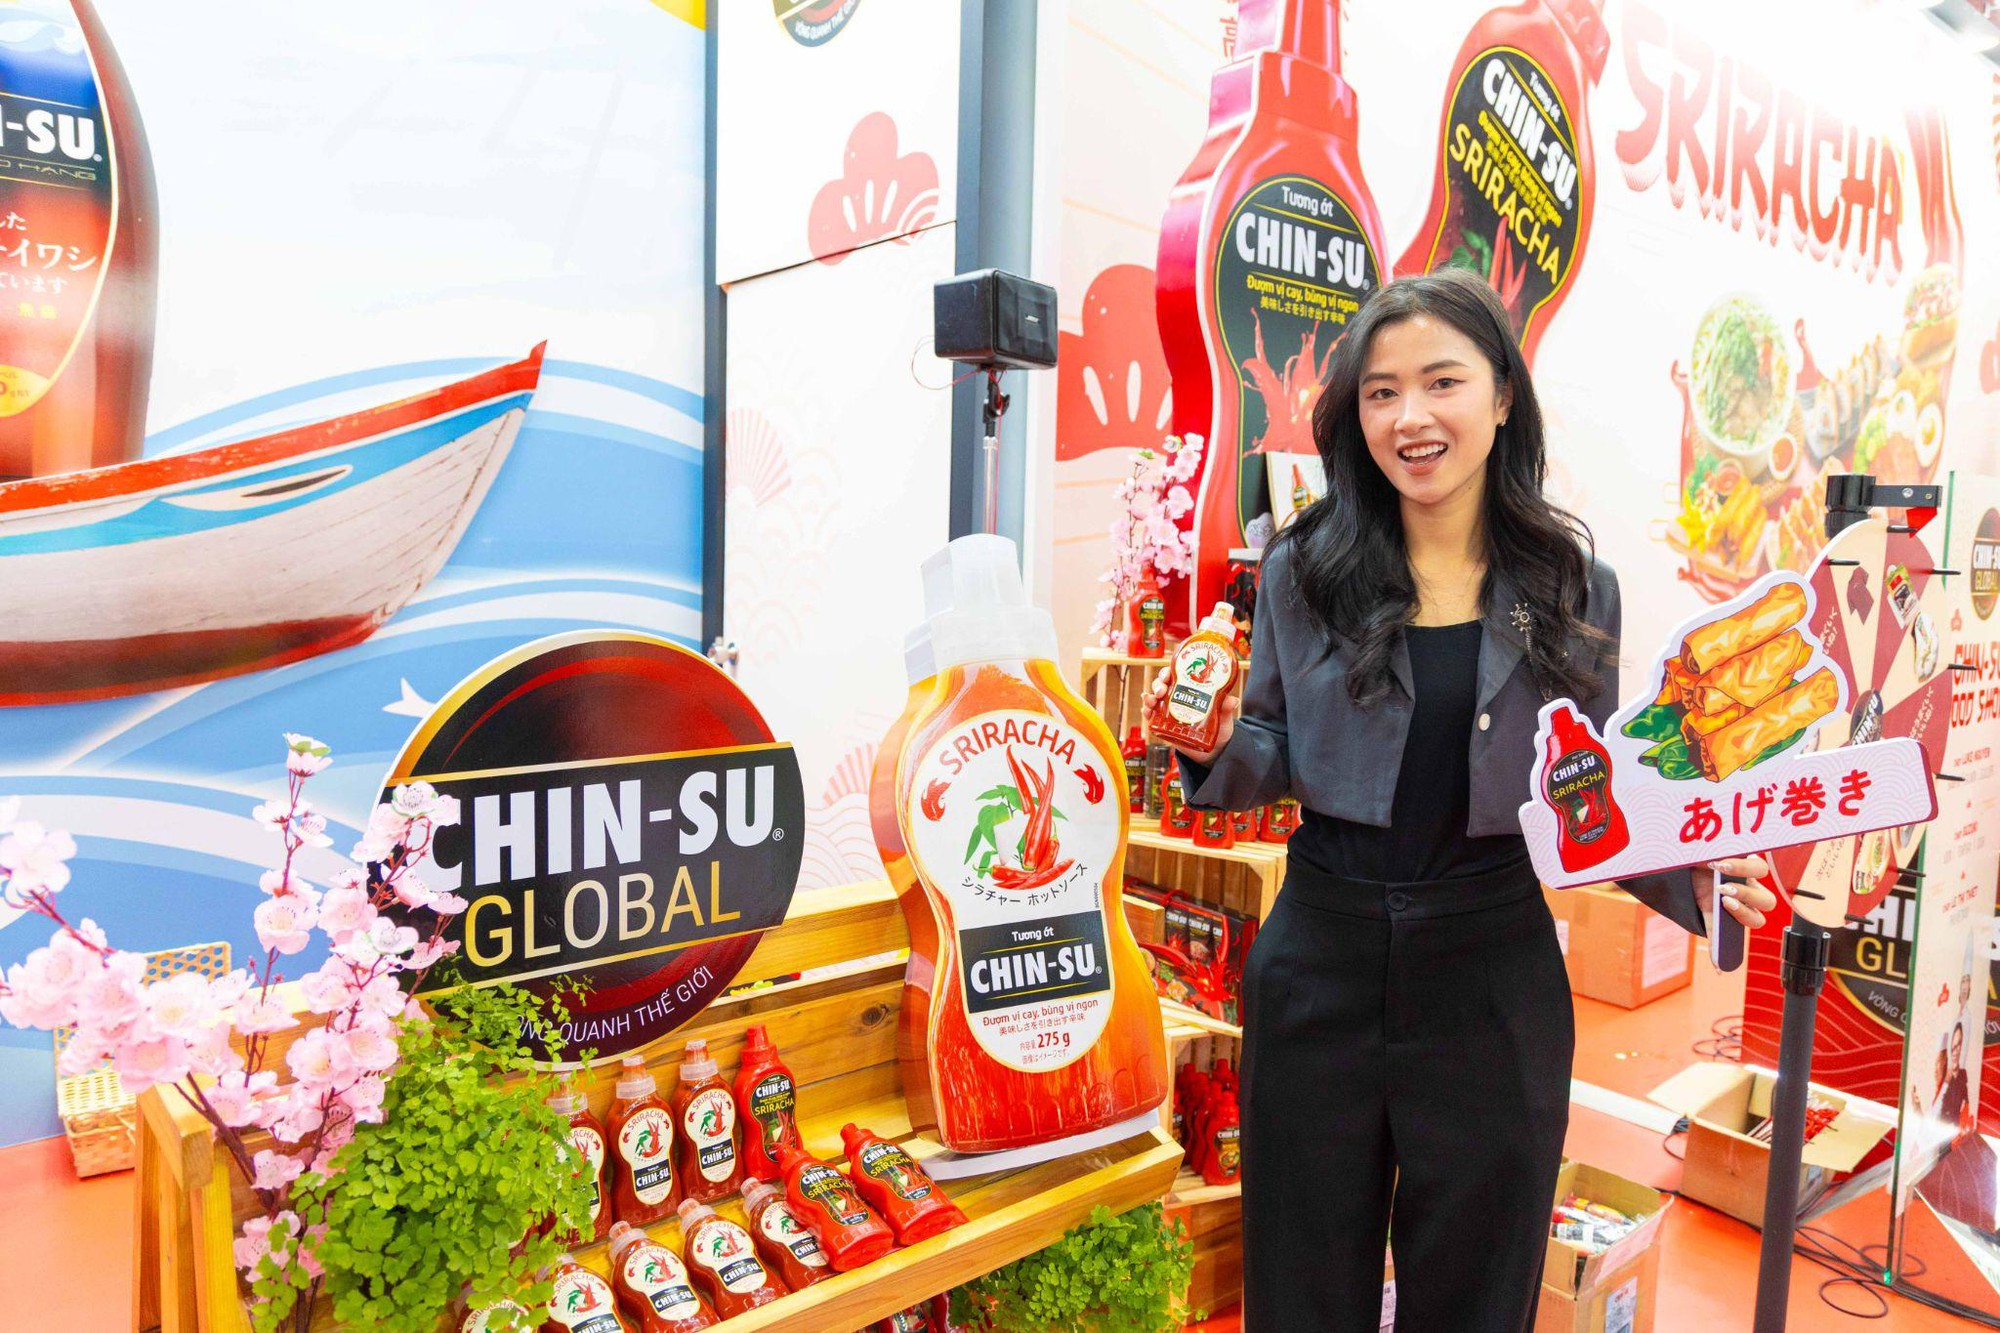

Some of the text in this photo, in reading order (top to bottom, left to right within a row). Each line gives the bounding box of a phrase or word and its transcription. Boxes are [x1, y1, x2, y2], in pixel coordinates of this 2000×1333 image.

[1615, 0, 1904, 274] SRIRACHA
[1281, 185, 1318, 217] Tương
[1450, 122, 1561, 285] SRIRACHA
[939, 719, 1076, 775] SRIRACHA
[1553, 755, 1595, 782] CHIN-SU
[1553, 771, 1605, 800] SRIRACHA
[1679, 769, 1872, 843] あげ巻き
[962, 876, 1020, 906] シラチャー
[1028, 863, 1088, 906] ホットソース
[465, 860, 740, 967] GLOBAL
[1011, 926, 1054, 942] Tương ớt
[559, 1013, 630, 1045] QUANH
[635, 988, 675, 1027] THẾ
[676, 965, 714, 1003] GIỚI
[982, 1013, 1010, 1027] Đượm
[1041, 1005, 1064, 1018] bùng
[1076, 999, 1098, 1013] ngon
[1037, 1031, 1060, 1048] 275
[1062, 1032, 1070, 1047] g
[756, 1080, 790, 1098] CHIN-SU
[754, 1097, 795, 1116] SRIRACHA
[627, 1111, 664, 1131] SRIRACHA
[702, 1148, 733, 1166] CHIN-SU
[870, 1156, 912, 1177] SRIRACHA
[636, 1166, 669, 1187] CHIN-SU
[802, 1168, 840, 1185] CHIN-SU
[808, 1181, 851, 1199] SRIRACHA
[723, 1260, 760, 1282] CHIN-SU
[654, 1287, 692, 1309] CHIN-SU
